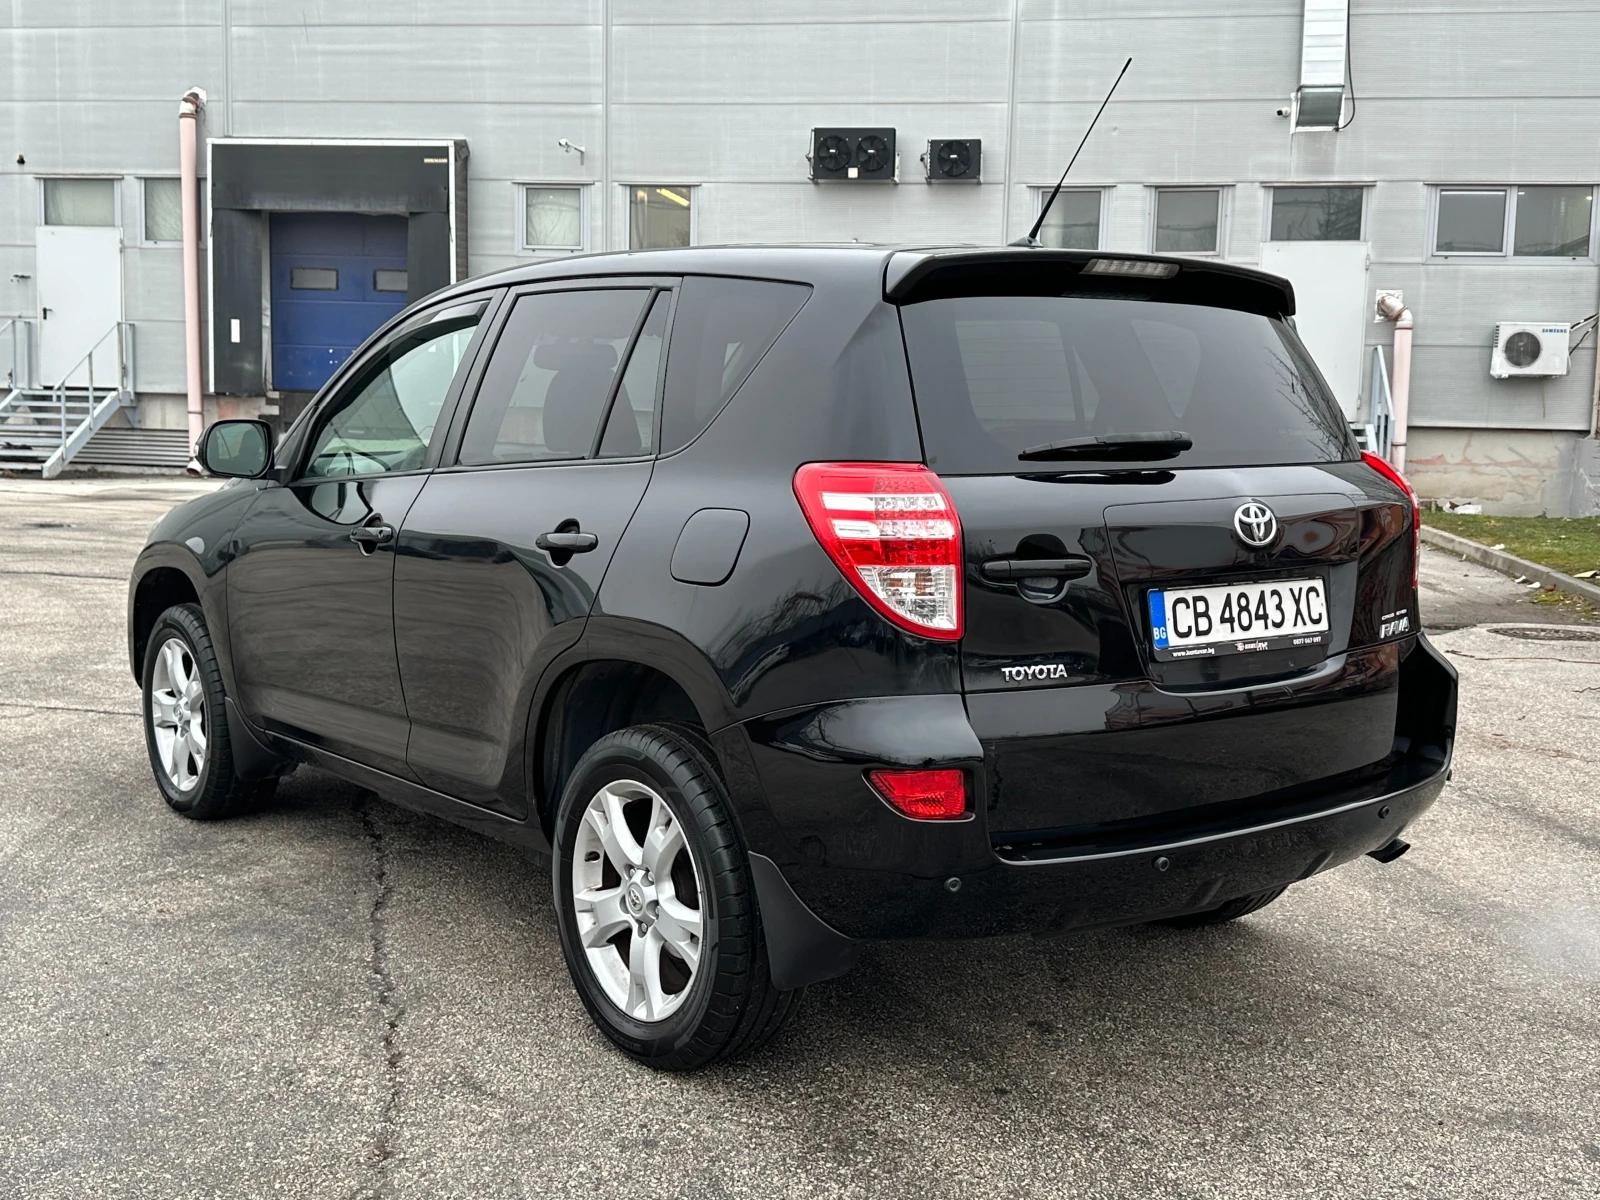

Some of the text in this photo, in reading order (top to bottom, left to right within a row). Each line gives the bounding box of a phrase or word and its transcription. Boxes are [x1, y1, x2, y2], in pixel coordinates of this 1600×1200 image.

[1172, 586, 1323, 639] CB 4843 XC
[1153, 627, 1167, 640] BG
[1001, 664, 1068, 681] TOYOTA
